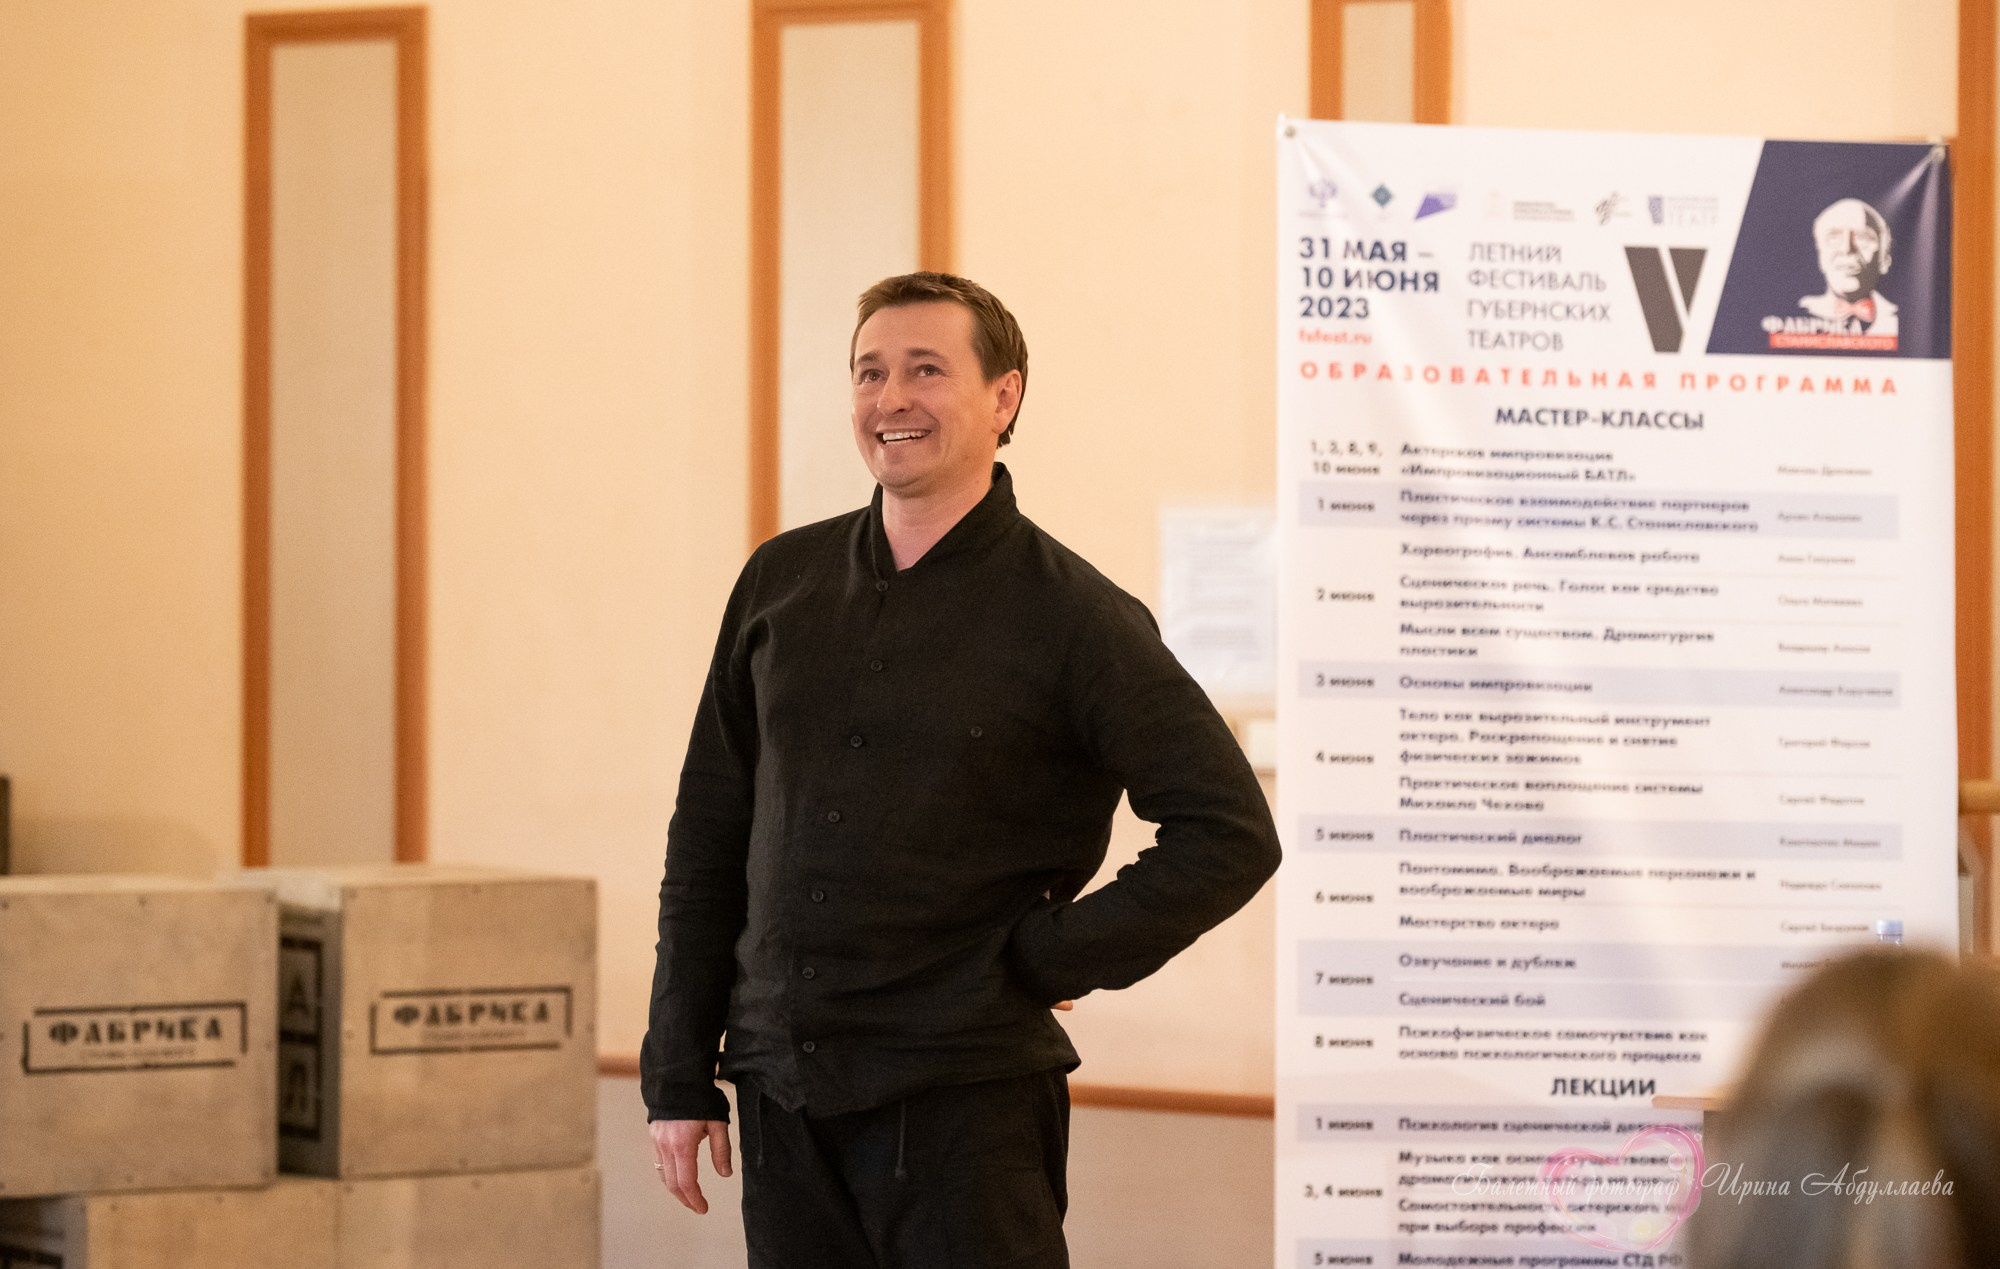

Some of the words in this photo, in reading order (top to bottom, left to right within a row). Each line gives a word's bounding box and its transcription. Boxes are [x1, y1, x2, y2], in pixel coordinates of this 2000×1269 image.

[1300, 237, 1330, 258] 31
[1344, 241, 1407, 262] МАЯ
[1468, 242, 1562, 263] ЛЕТНИЙ
[1301, 267, 1333, 289] 10
[1344, 269, 1439, 292] ИЮНЯ
[1468, 269, 1606, 292] ФЕСТИВАЛЬ
[1300, 296, 1369, 319] 2023
[1467, 300, 1610, 322] ГУБЕРНСКИХ
[1468, 330, 1564, 351] ТЕАТРОВ
[1300, 361, 1656, 389] ОБРАЗОВАТЕЛЬНАЯ
[1681, 373, 1898, 396] ПРОГРАММА
[1496, 407, 1704, 431] МАСТЕР-КЛАССЫ
[1551, 1077, 1656, 1098] ЛЕКЦИИ
